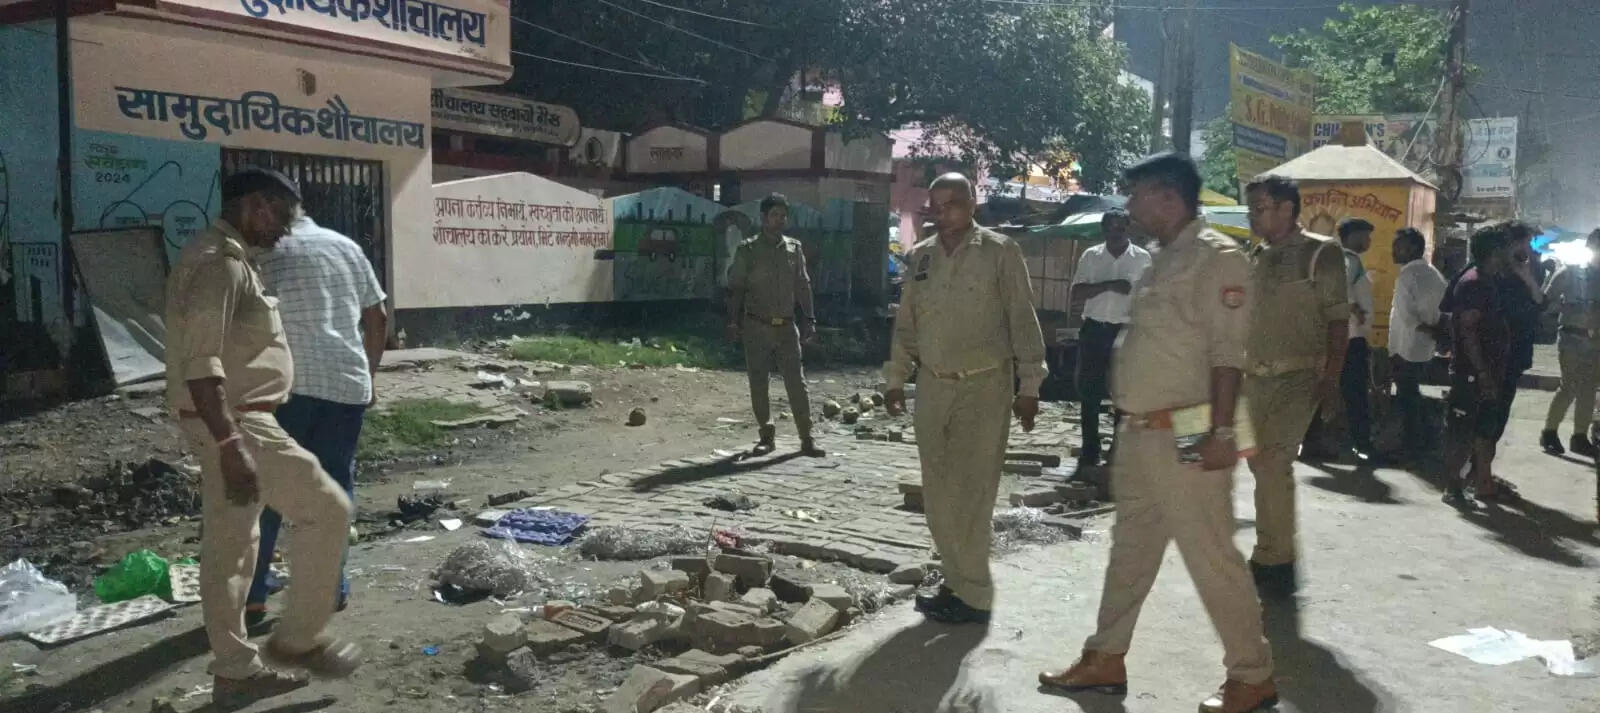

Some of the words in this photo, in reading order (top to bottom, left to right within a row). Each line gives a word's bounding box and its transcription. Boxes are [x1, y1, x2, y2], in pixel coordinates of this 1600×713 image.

[96, 171, 130, 183] 2024
[1350, 192, 1402, 223] अभियान
[432, 219, 475, 247] शौचालय
